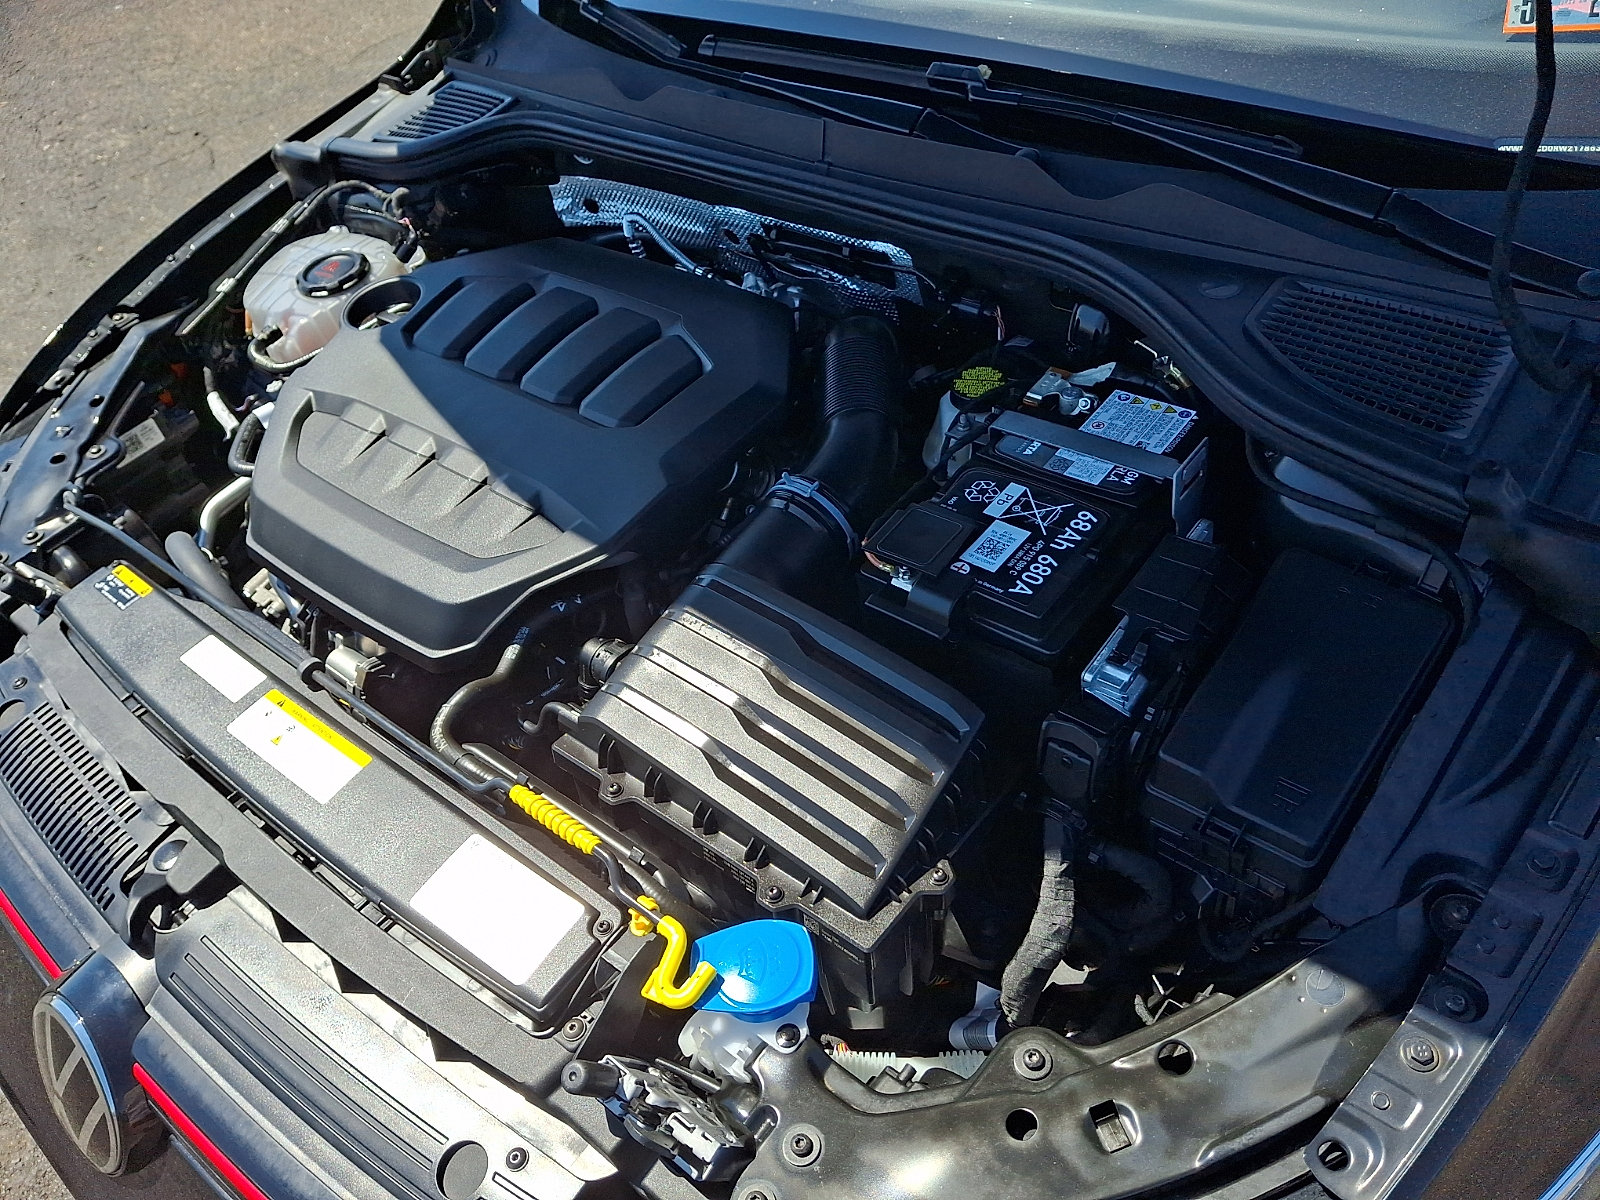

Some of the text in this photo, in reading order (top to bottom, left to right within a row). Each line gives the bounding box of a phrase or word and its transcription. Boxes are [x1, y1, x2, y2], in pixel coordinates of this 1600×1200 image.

[997, 492, 1014, 506] Pb
[1049, 511, 1098, 550] 68Ah
[1008, 554, 1059, 595] 680A
